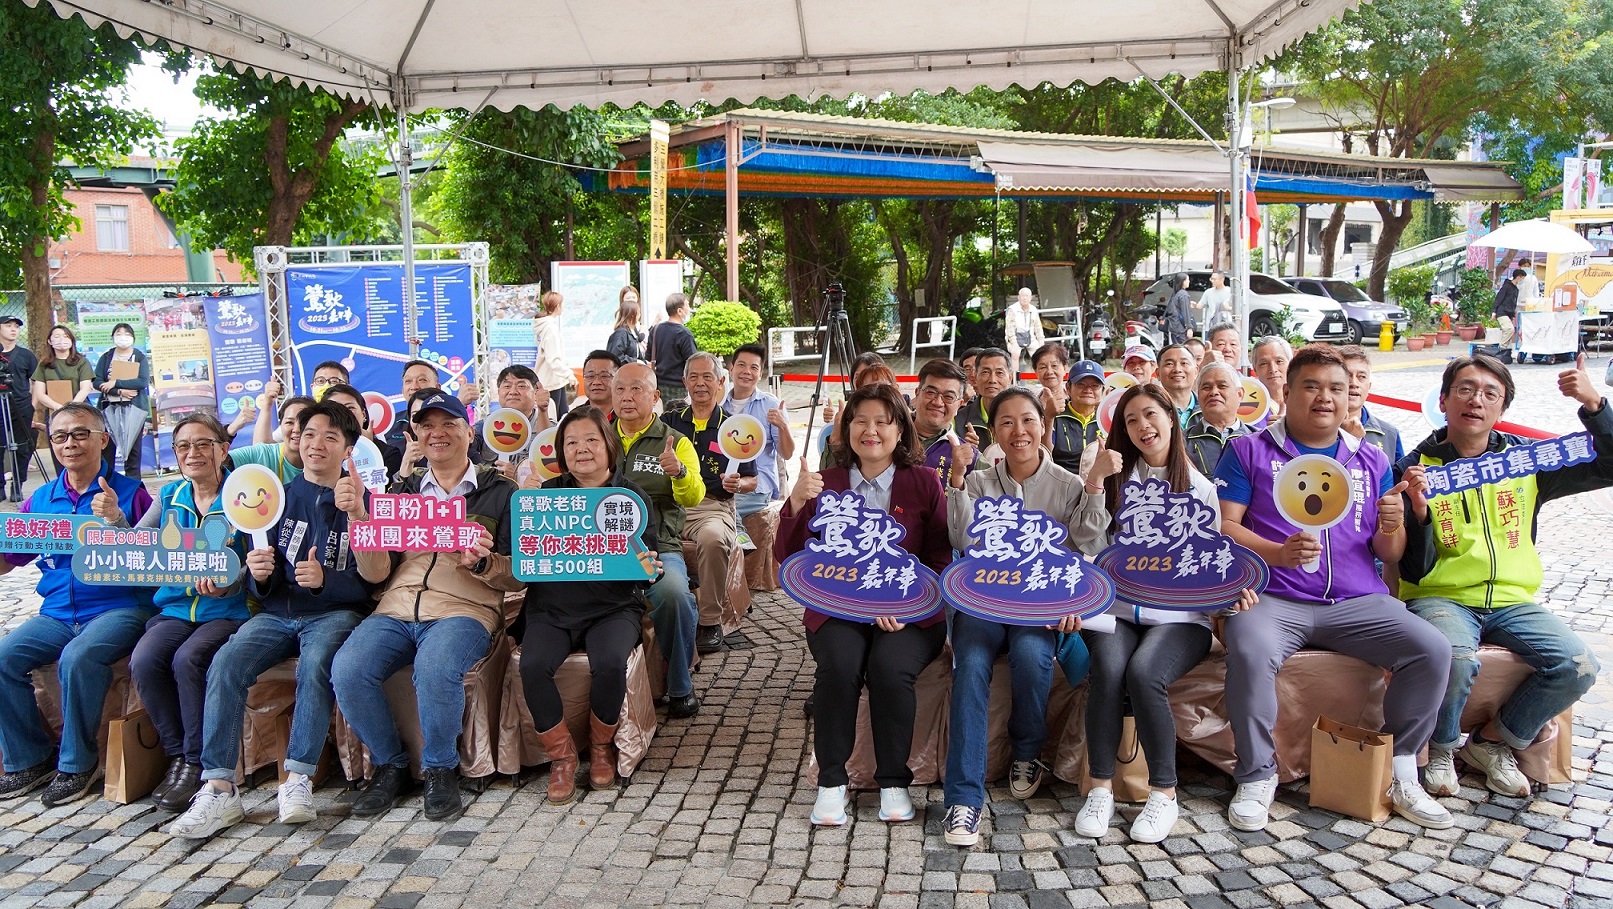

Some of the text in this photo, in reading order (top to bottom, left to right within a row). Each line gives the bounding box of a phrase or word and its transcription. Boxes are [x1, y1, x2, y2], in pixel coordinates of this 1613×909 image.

[303, 283, 344, 313] 鶯歌
[217, 300, 247, 320] 鶯歌
[307, 314, 328, 322] 2023
[1426, 435, 1591, 495] 陶瓷市集尋寶
[373, 497, 463, 521] 圈粉1+1
[519, 494, 587, 512] 鶯歌老街
[603, 501, 634, 517] 實境
[6, 518, 73, 539] 換好禮
[519, 514, 592, 532] 真人NPC
[603, 517, 634, 533] 解謎
[809, 493, 903, 563] 鶯歌
[1118, 483, 1216, 551] 鶯歌
[1495, 489, 1520, 550] 蘇巧慧
[86, 529, 158, 546] 限量80組!
[354, 524, 483, 550] 揪團來鶯歌
[969, 498, 1068, 566] 鶯歌
[519, 533, 628, 555] 等你來挑戰
[84, 550, 228, 572] 小小職人開課啦
[519, 558, 604, 577] 限量500組
[1125, 542, 1235, 582] 2023 嘉年華
[811, 557, 918, 599] 2023 嘉年華
[974, 557, 1084, 597] 2023 嘉年華
